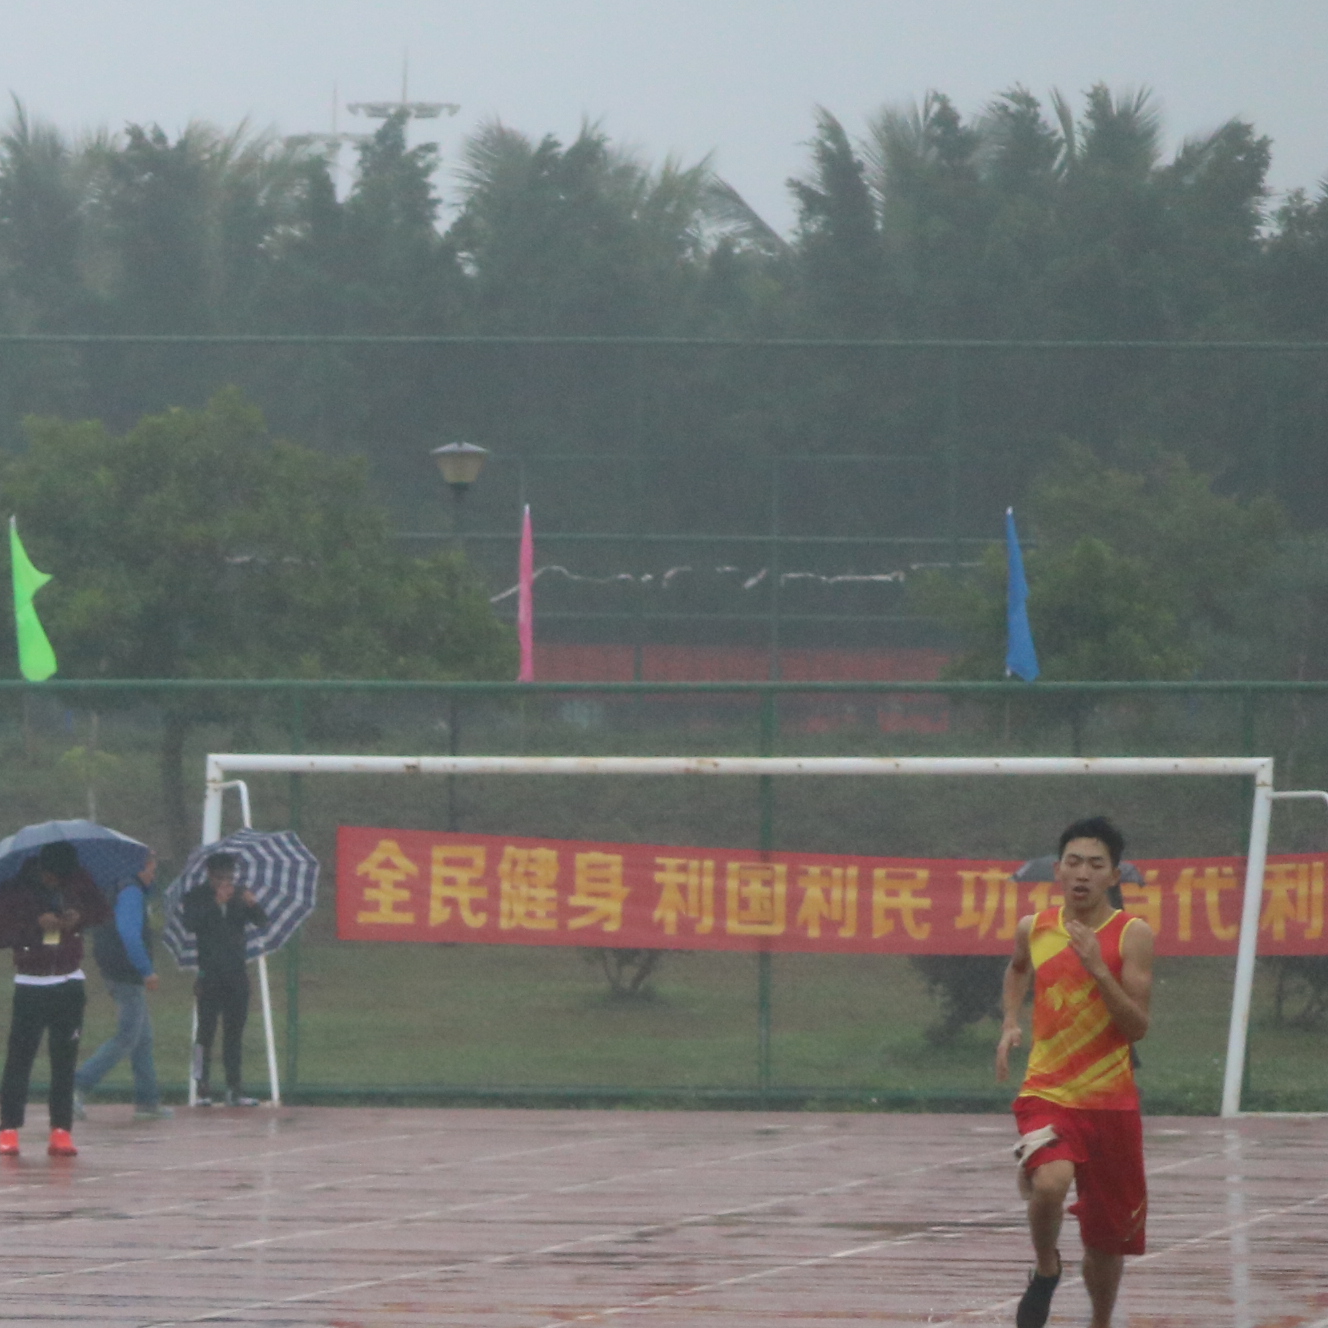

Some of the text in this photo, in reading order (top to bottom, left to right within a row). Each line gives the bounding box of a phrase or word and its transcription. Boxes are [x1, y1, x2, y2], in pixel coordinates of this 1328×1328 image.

[355, 838, 631, 932] 全民健身
[652, 855, 932, 940] 利国利民
[953, 865, 1240, 941] 功当代
